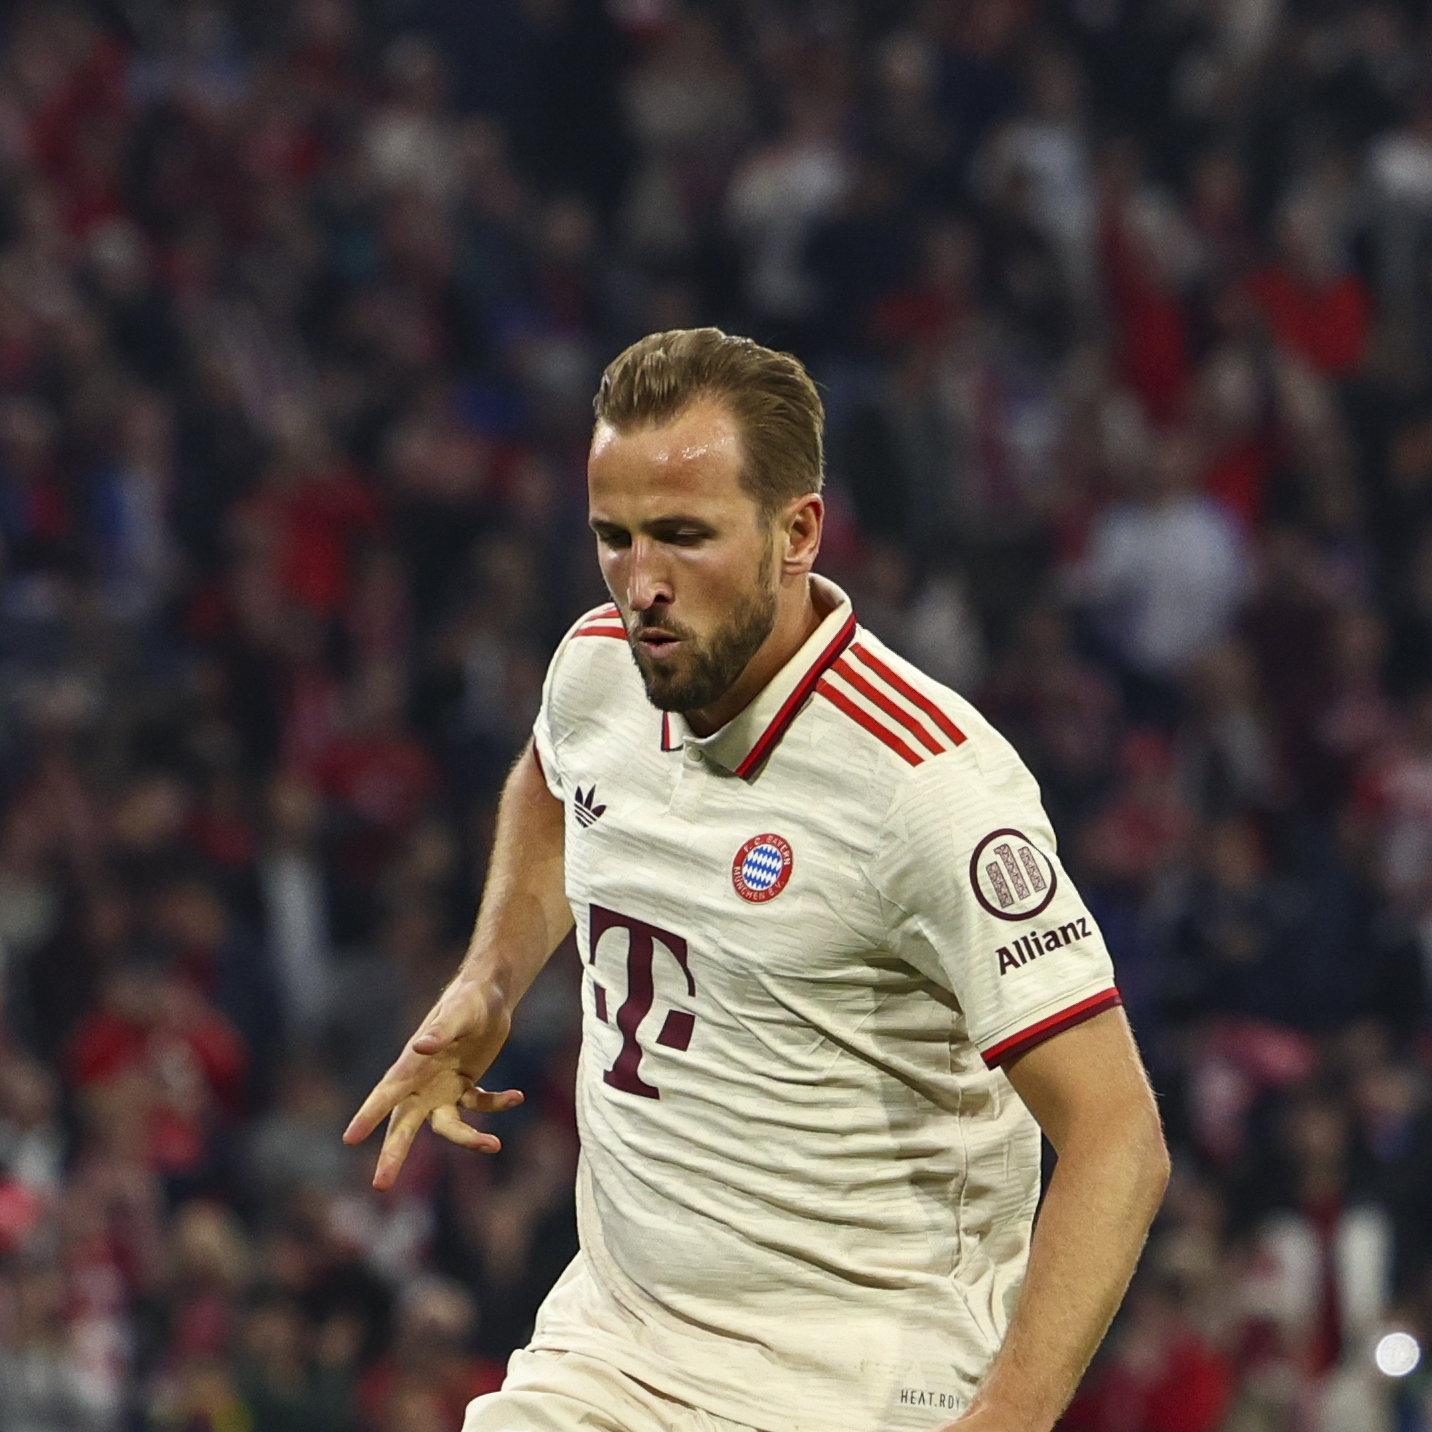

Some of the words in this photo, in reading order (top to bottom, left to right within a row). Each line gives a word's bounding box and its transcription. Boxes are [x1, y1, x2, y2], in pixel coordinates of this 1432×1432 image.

[766, 834, 791, 866] BAYERN
[733, 866, 766, 901] MÜNCHEN
[995, 917, 1092, 976] Allianz
[900, 1389, 961, 1411] HEAT.RDY
